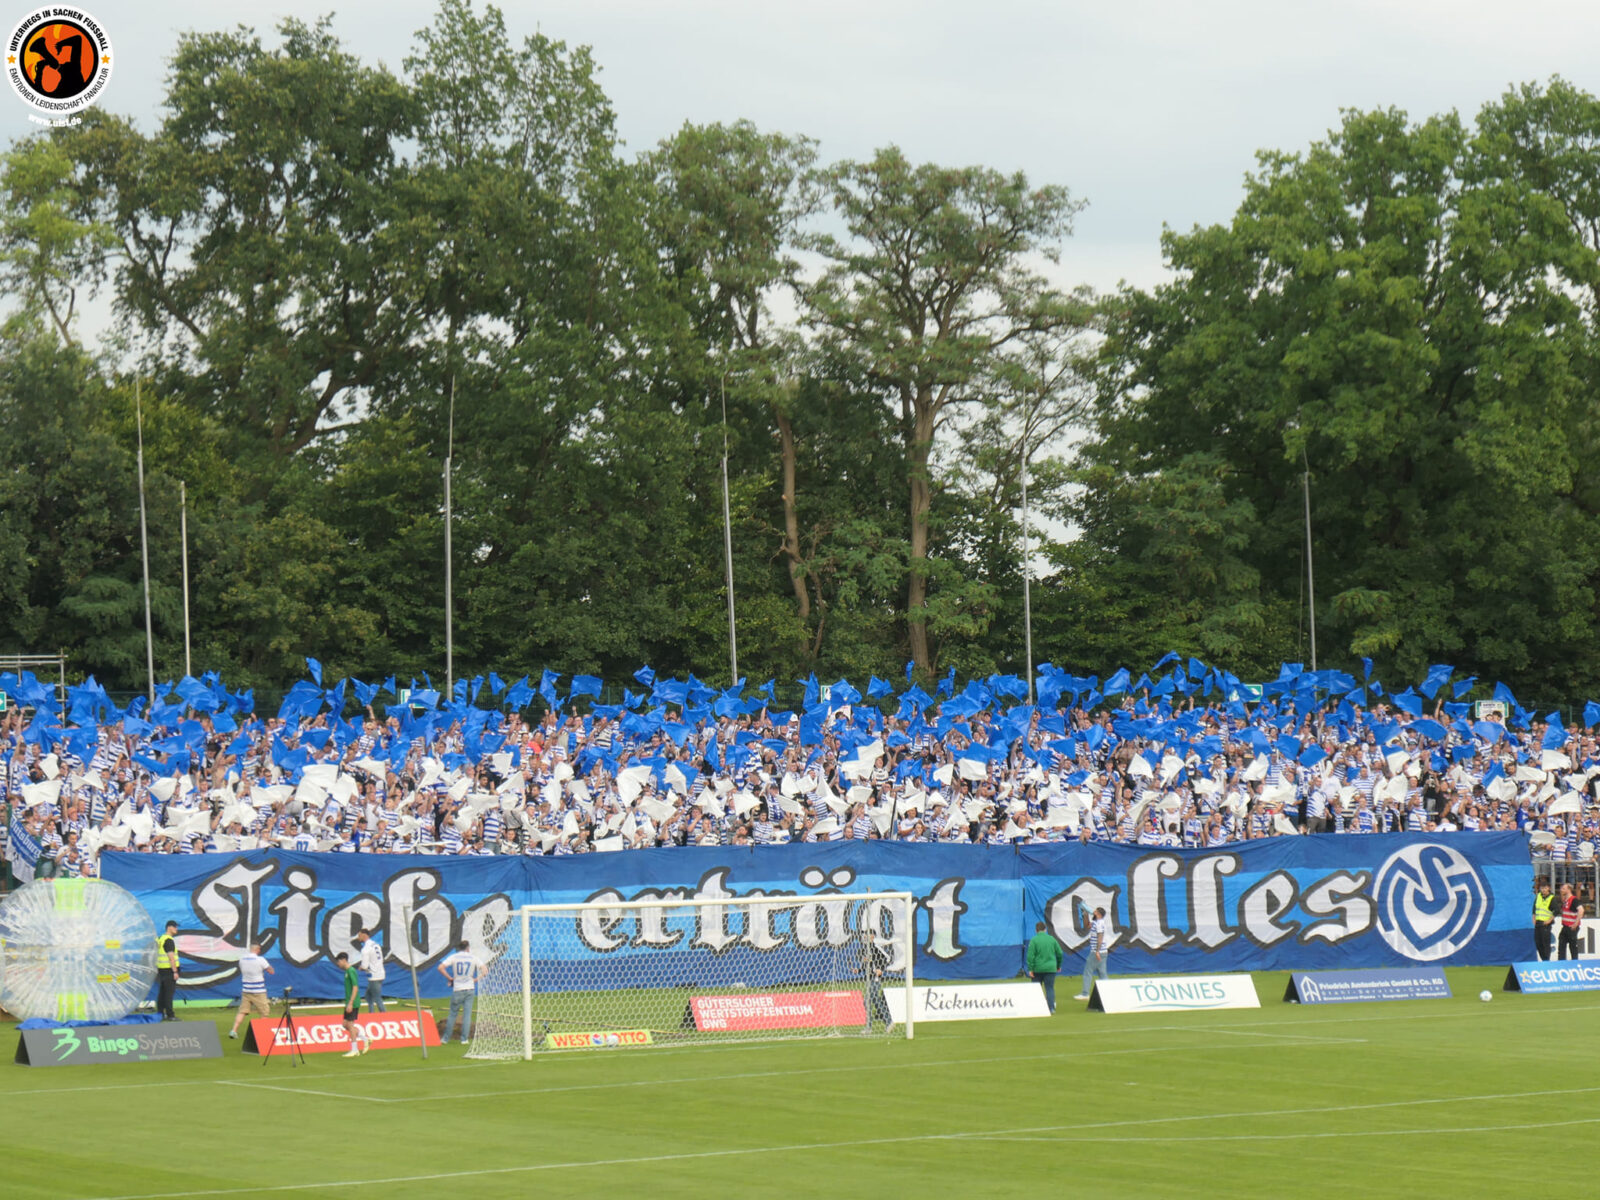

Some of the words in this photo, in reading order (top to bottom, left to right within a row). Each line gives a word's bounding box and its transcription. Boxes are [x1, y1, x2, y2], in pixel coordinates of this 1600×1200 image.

[174, 857, 514, 990] Liebe
[576, 865, 969, 972] erträgt
[1044, 852, 1378, 955] alles
[456, 961, 472, 976] 07
[1531, 964, 1600, 983] euronics
[922, 988, 1014, 1011] Rickmann
[1130, 980, 1226, 1002] TÖNNIES
[697, 996, 774, 1010] GÜTERSLOHER
[698, 1005, 813, 1019] WERTSTOFFZENTRUM
[702, 1018, 727, 1029] GWG
[87, 1036, 139, 1055] Bingo
[552, 1033, 591, 1047] WEST
